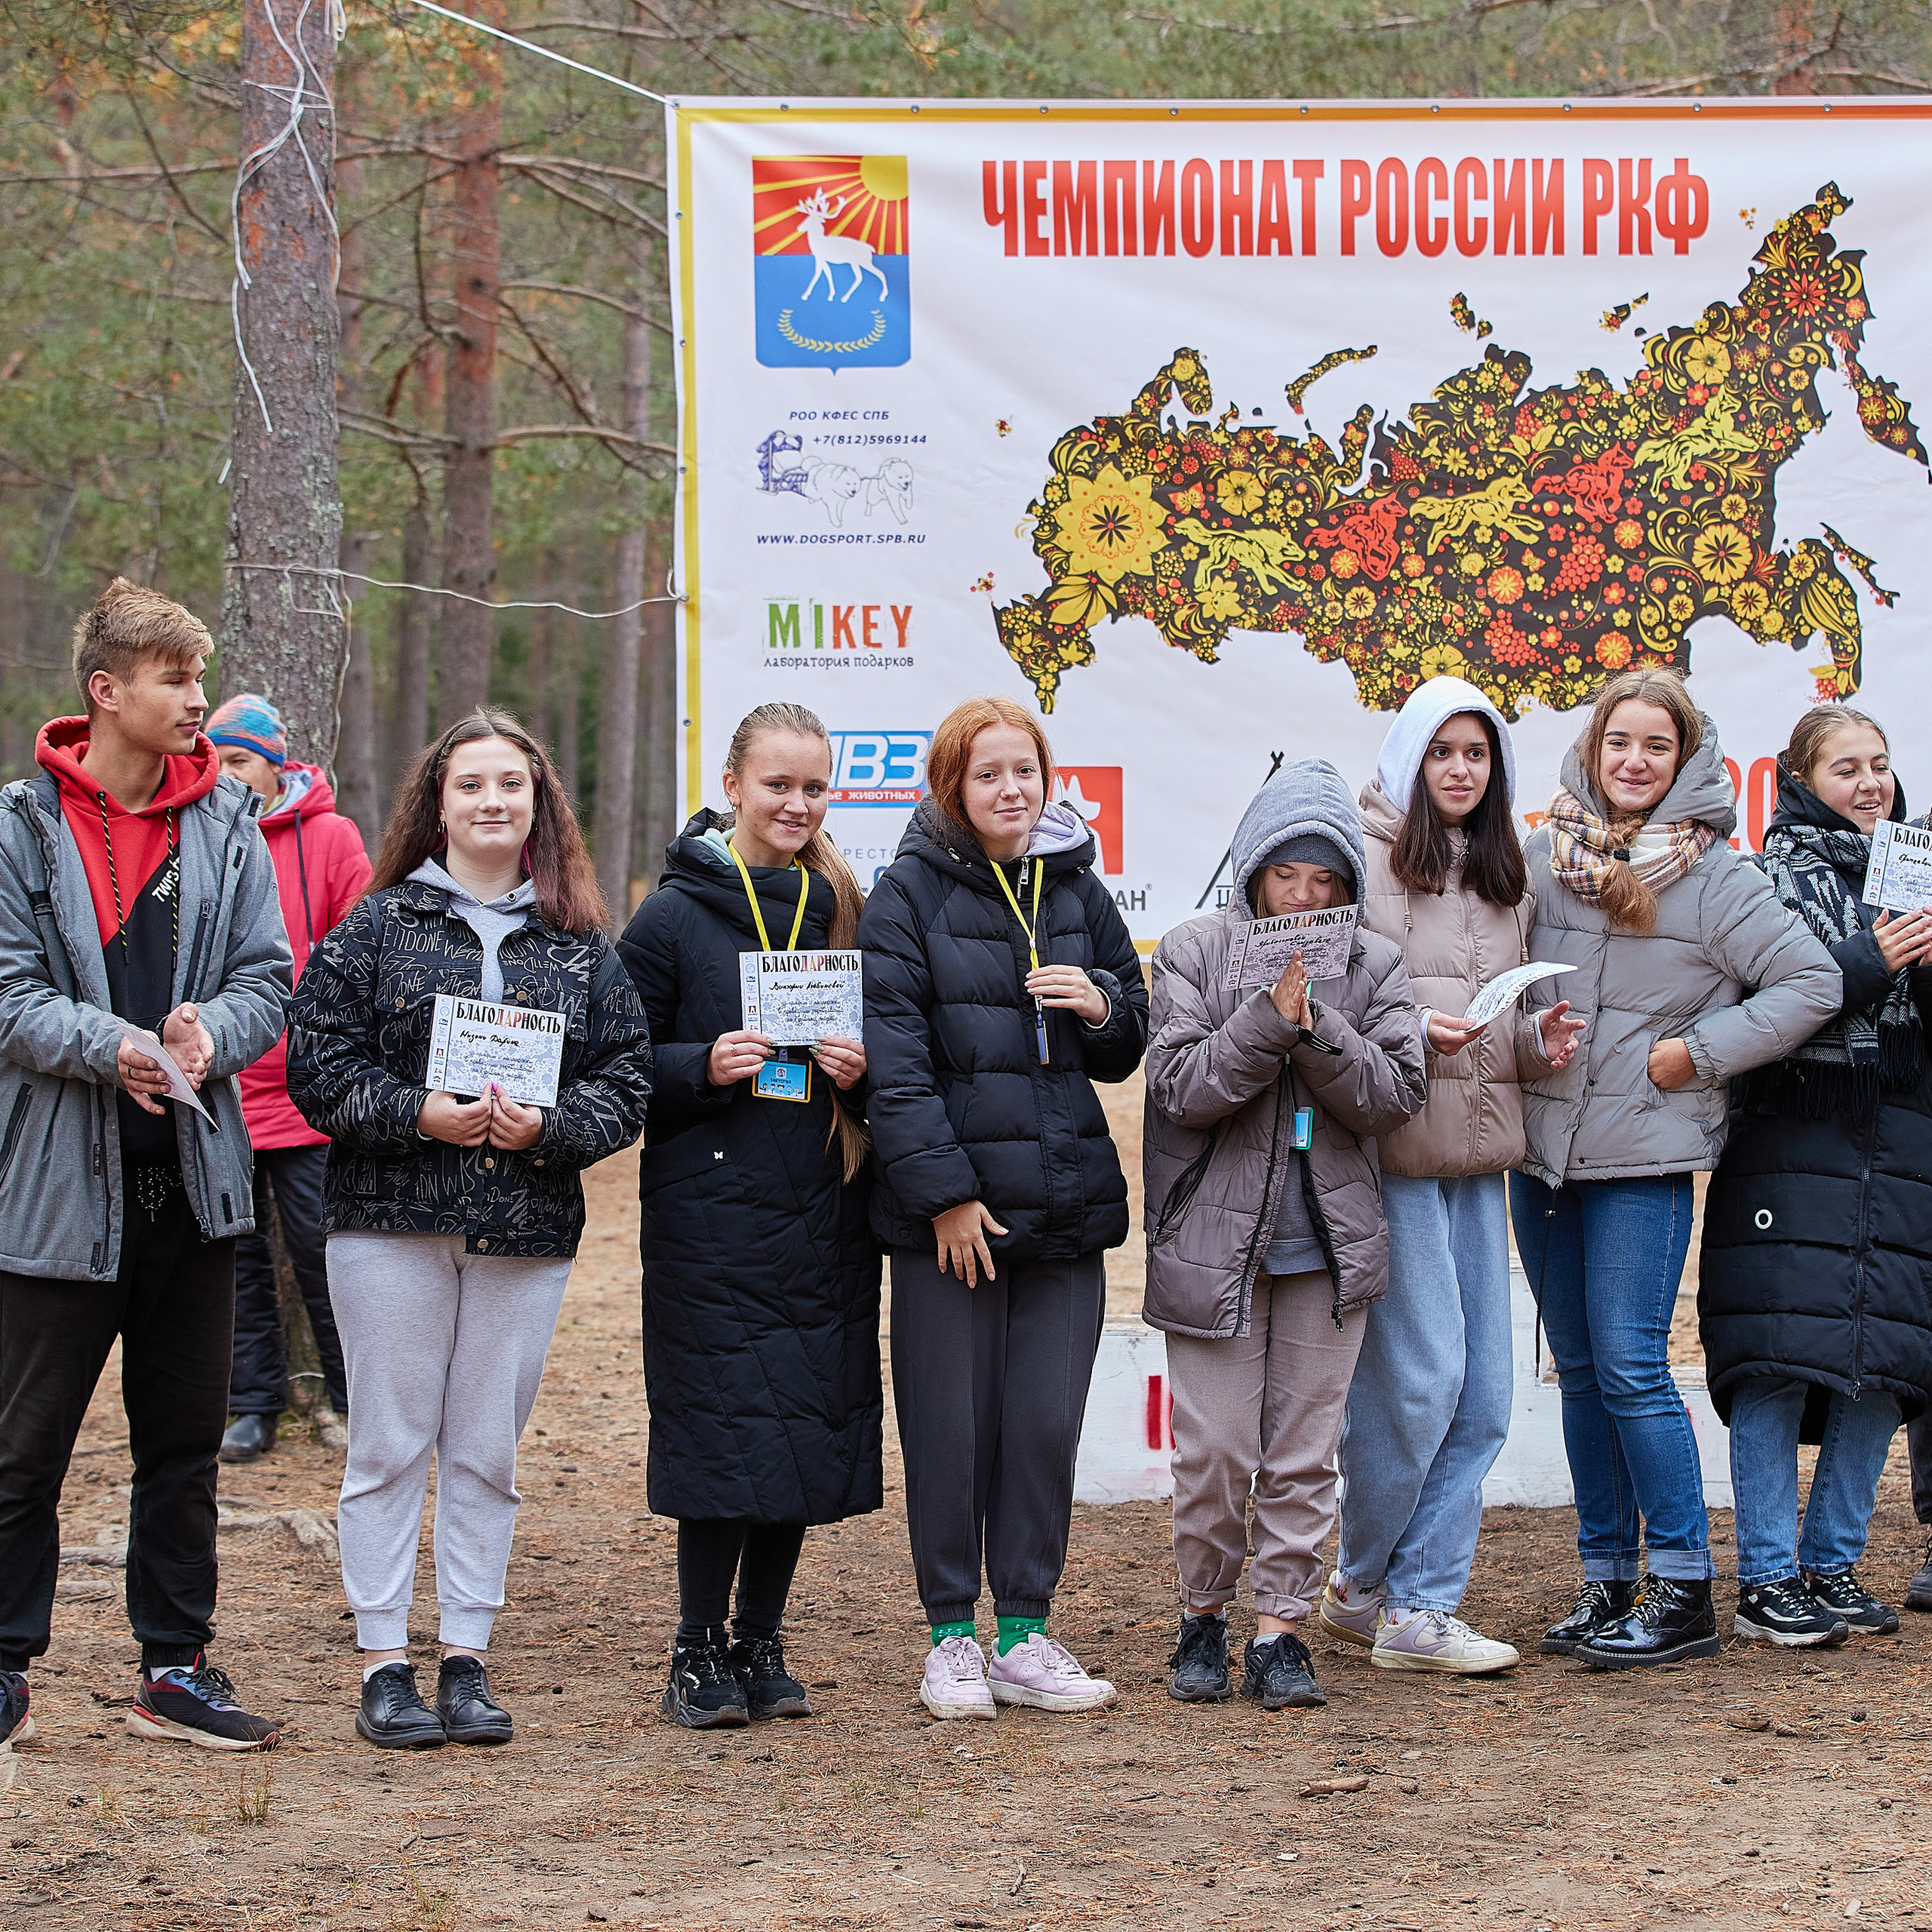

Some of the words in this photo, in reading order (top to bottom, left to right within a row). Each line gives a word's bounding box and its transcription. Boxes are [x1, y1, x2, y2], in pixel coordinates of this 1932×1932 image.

[982, 158, 1325, 259] ЧЕМПИОНАТ
[1340, 157, 1564, 259] РОССИИ
[1582, 158, 1709, 257] РКФ
[789, 411, 817, 420] РОО
[823, 411, 858, 420] КФЕС
[863, 411, 890, 420] СПБ
[813, 435, 928, 446] +7(812)5969144
[757, 534, 926, 544] WWW.DOGSPORT.SPB.RU
[768, 604, 913, 650] MIKEY
[764, 656, 850, 670] лаборатория
[854, 654, 914, 670] подарков
[848, 791, 915, 801] животных
[1894, 827, 1932, 851] БЛАГО
[1253, 909, 1353, 936] БЛАГОДАРНОСТЬ
[761, 955, 859, 973] БЛАГОДАРНОСТЬ
[456, 1001, 561, 1034] БЛАГОДАРНОСТЬ
